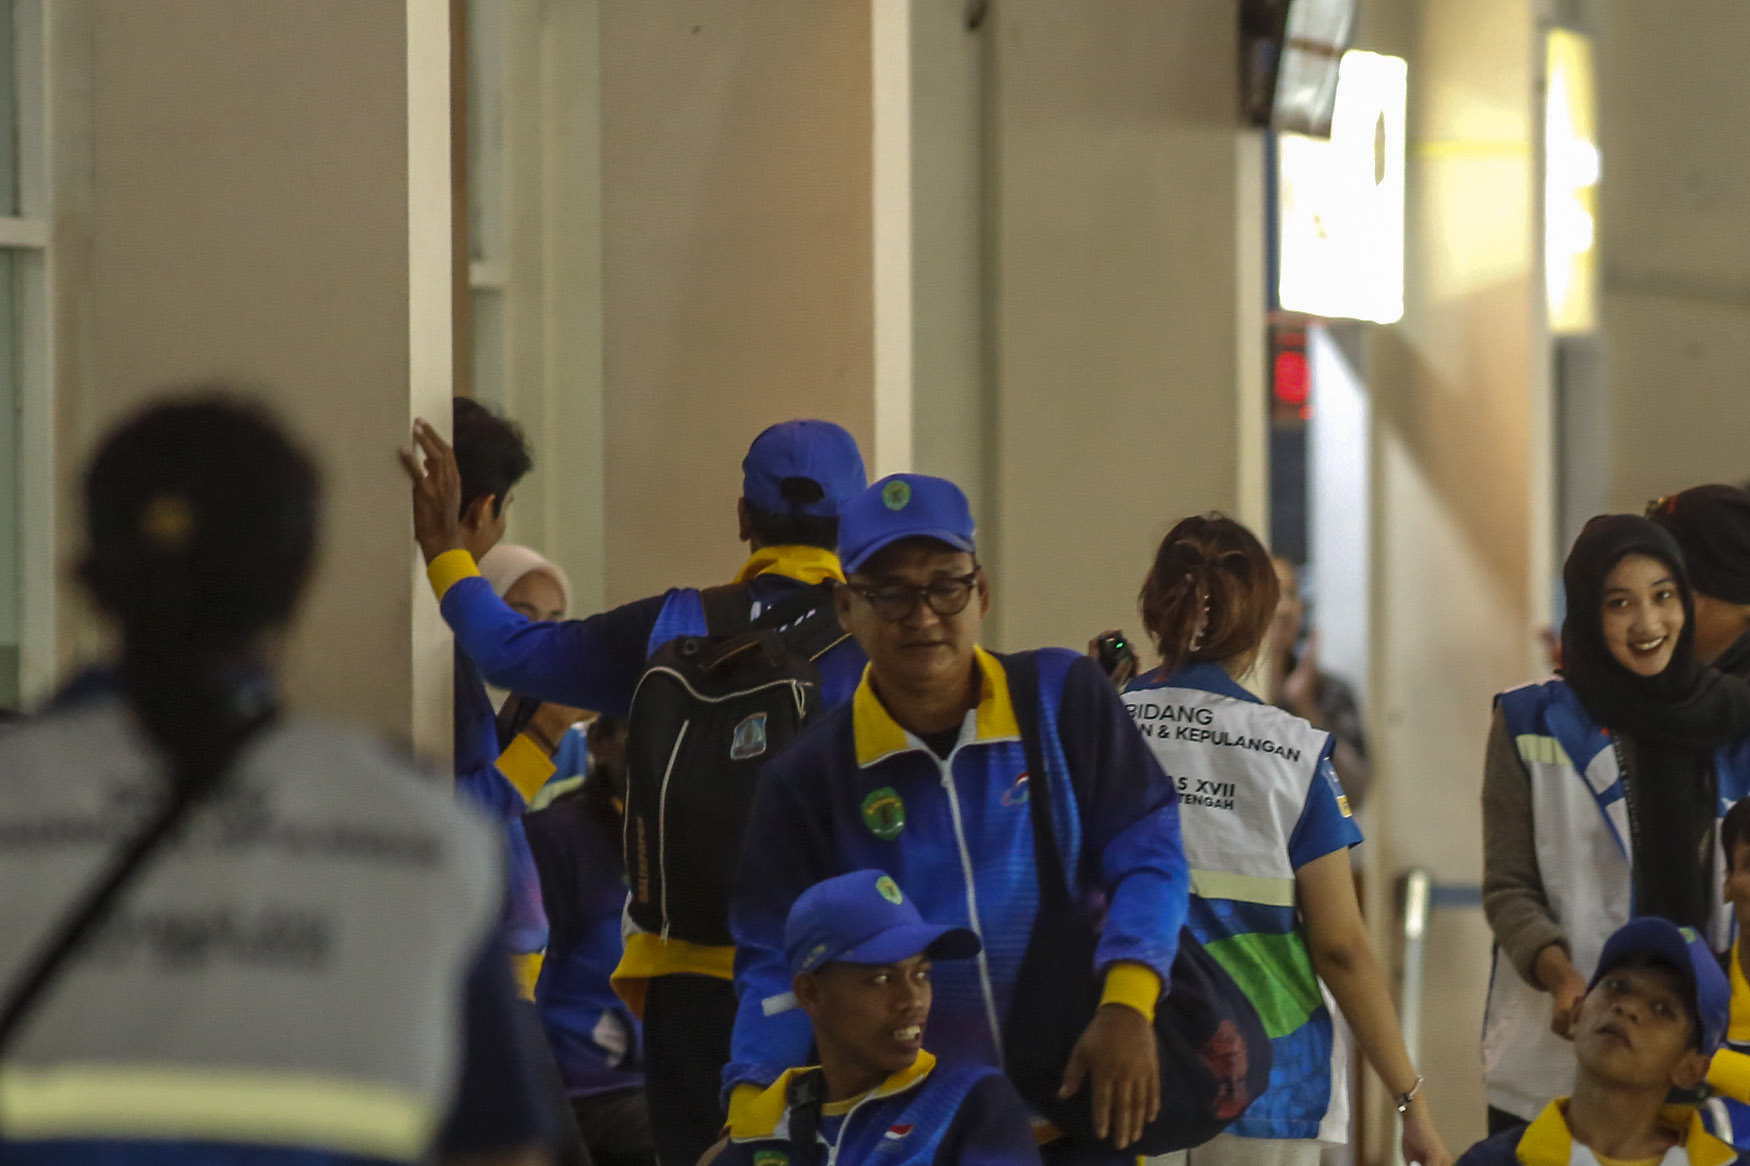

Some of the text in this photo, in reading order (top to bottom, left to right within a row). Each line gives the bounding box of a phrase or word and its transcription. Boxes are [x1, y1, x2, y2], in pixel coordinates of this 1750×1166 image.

[1158, 724, 1171, 739] &
[1175, 726, 1301, 762] KEPULANGAN
[1194, 779, 1236, 797] XVII
[1178, 792, 1234, 811] TENGAH
